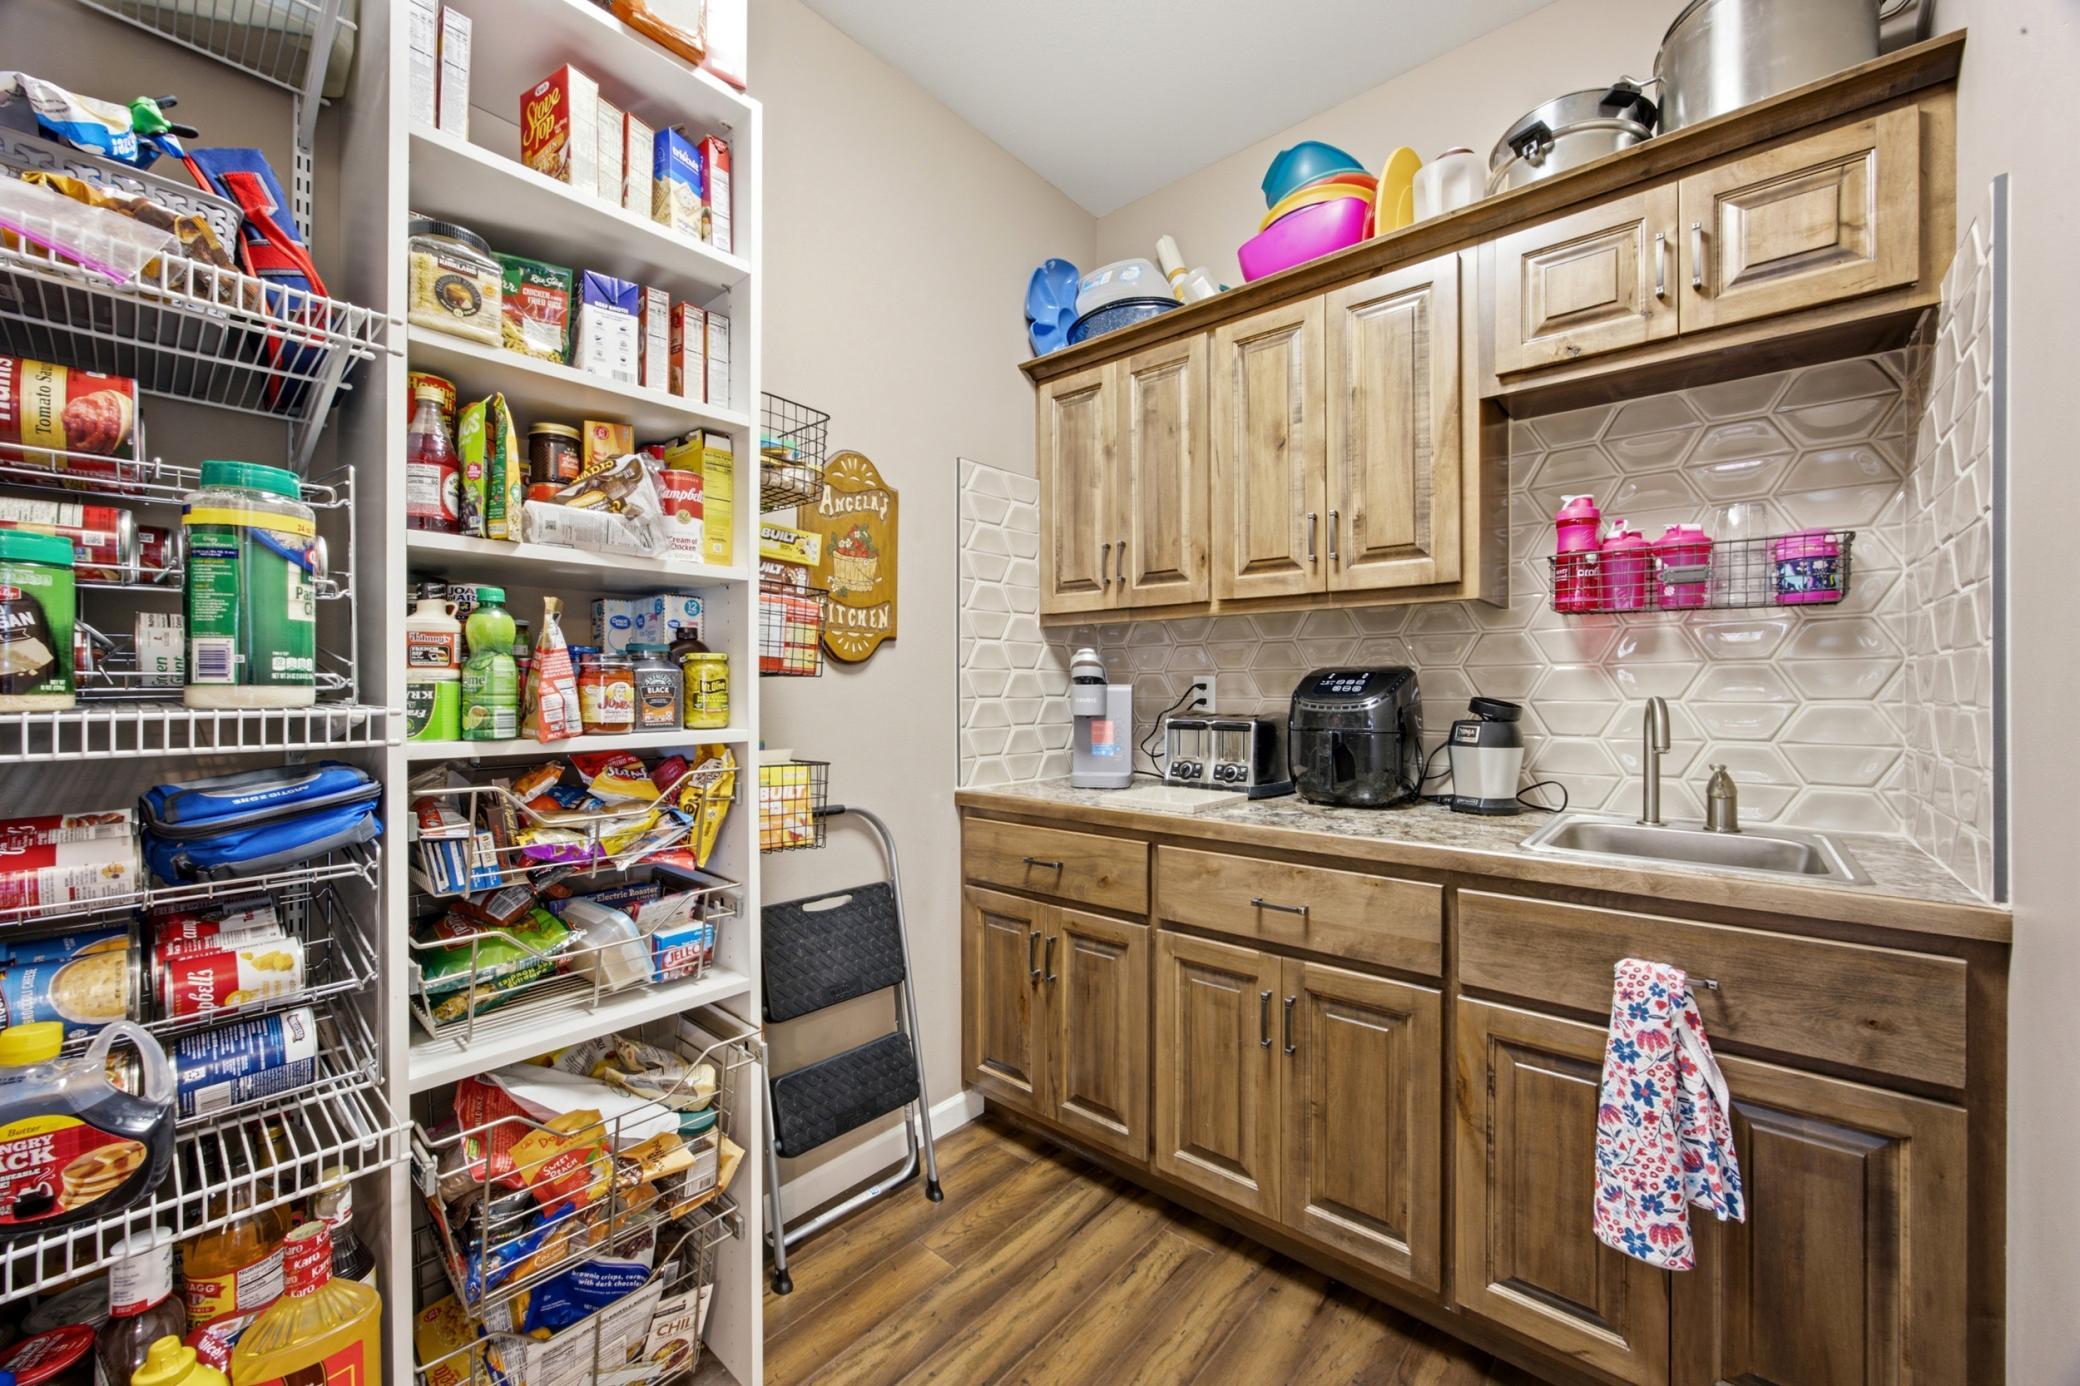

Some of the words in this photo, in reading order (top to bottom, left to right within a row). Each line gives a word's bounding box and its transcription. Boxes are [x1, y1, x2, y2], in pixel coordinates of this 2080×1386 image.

[35, 384, 52, 435] Tomato
[760, 527, 798, 545] BUILT
[448, 586, 476, 596] JOA
[596, 890, 628, 903] Electric
[628, 885, 659, 899] Roaster
[7, 1125, 41, 1138] Butter
[0, 1133, 55, 1156] NGRY
[285, 1243, 304, 1256] aro
[293, 1252, 321, 1270] Karo
[290, 1283, 316, 1299] Karo
[577, 1278, 594, 1287] with
[594, 1279, 613, 1288] dark
